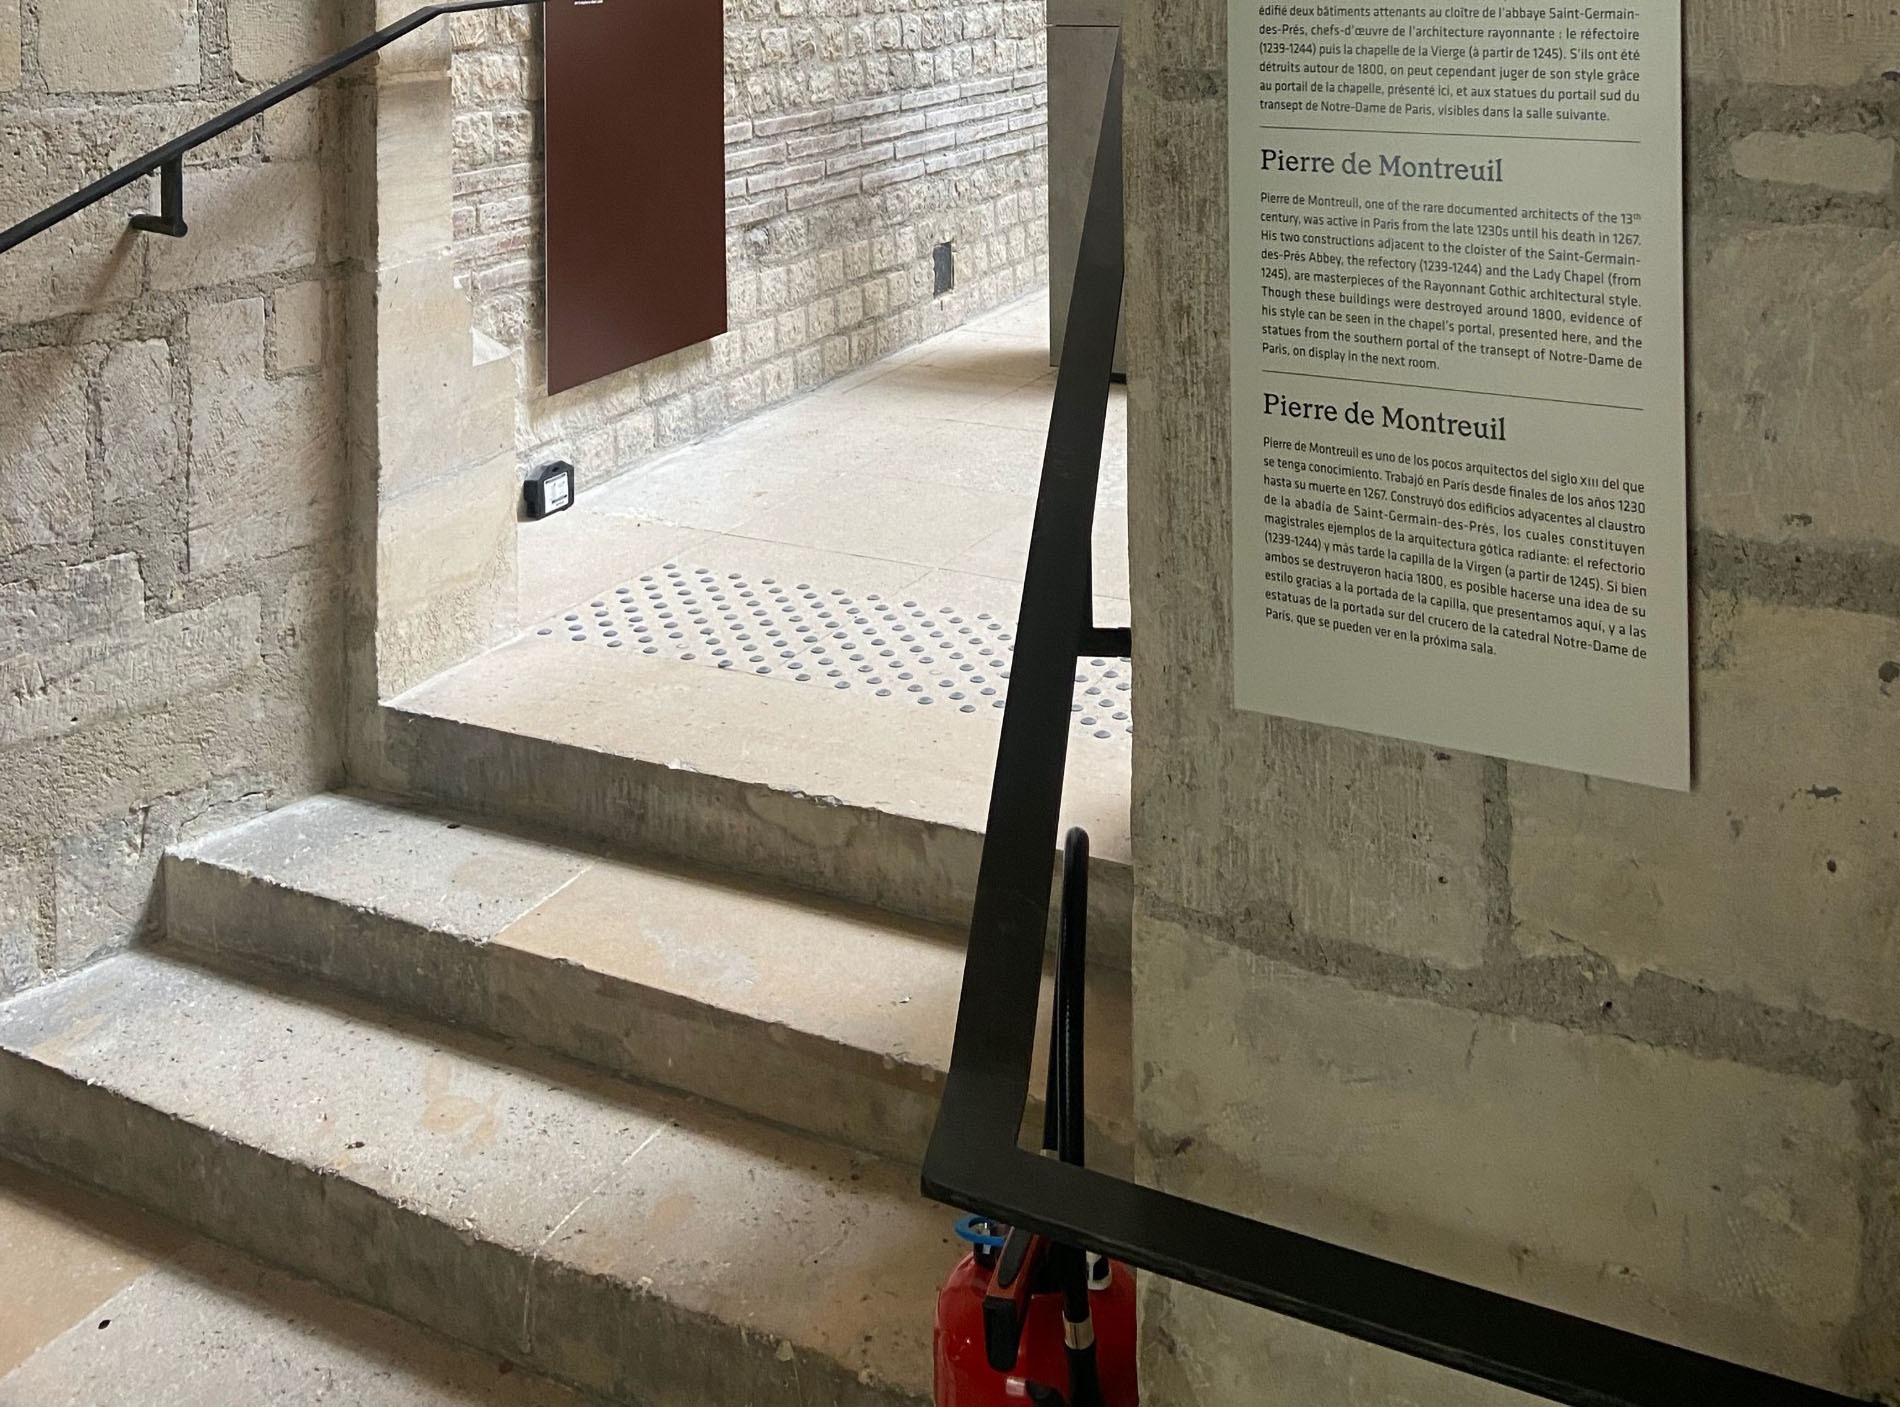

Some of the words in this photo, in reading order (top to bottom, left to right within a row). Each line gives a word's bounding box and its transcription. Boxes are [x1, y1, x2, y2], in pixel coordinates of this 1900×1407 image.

[1258, 4, 1288, 16] édifié
[1288, 4, 1314, 16] deux
[1316, 4, 1371, 17] bâtiments
[1372, 6, 1426, 18] attenants
[1428, 8, 1442, 18] au
[1481, 6, 1496, 18] de
[1548, 6, 1640, 20] Saint-Germain-
[1258, 60, 1300, 73] détruits
[1303, 63, 1339, 74] autour
[1341, 62, 1354, 75] de
[1389, 66, 1404, 75] on
[1407, 66, 1433, 78] peut
[1435, 65, 1496, 79] cependant
[1498, 66, 1529, 82] juger
[1531, 67, 1546, 79] de
[1549, 70, 1571, 80] son
[1574, 68, 1604, 83] style
[1606, 69, 1640, 84] grâce
[1259, 99, 1303, 113] transept
[1304, 99, 1319, 112] de
[1320, 100, 1386, 114] Notre-Dame
[1388, 102, 1402, 114] de
[1437, 104, 1480, 117] visibles
[1481, 105, 1510, 118] dans
[1512, 106, 1523, 119] la
[1526, 106, 1553, 120] salle
[1260, 148, 1335, 174] Pierre
[1340, 151, 1372, 176] de
[1378, 154, 1503, 182] Montreuil
[1260, 229, 1278, 241] His
[1279, 231, 1300, 243] two
[1302, 234, 1375, 248] constructions
[1377, 238, 1424, 252] adjacent
[1427, 241, 1440, 252] to
[1442, 241, 1462, 254] the
[1464, 243, 1506, 257] cloister
[1509, 245, 1522, 258] of
[1524, 247, 1545, 260] the
[1547, 248, 1640, 266] Saint-Germain-
[1260, 247, 1306, 262] des-Prés
[1346, 254, 1365, 266] the
[1367, 255, 1417, 272] refectory
[1418, 258, 1482, 277] (1239-1244)
[1485, 264, 1507, 277] and
[1509, 266, 1530, 279] the
[1532, 267, 1561, 283] Lady
[1563, 269, 1604, 286] Chapel
[1607, 272, 1641, 287] (from
[1260, 285, 1302, 302] Though
[1304, 288, 1336, 303] these
[1338, 291, 1390, 310] buildings
[1393, 298, 1421, 310] were
[1424, 298, 1482, 316] destroyed
[1486, 306, 1528, 318] around
[1569, 311, 1624, 327] evidence
[1628, 315, 1642, 328] of
[1261, 324, 1302, 338] statues
[1303, 326, 1330, 340] from
[1332, 329, 1351, 342] the
[1405, 338, 1439, 350] portal
[1442, 339, 1455, 351] of
[1457, 341, 1477, 354] the
[1479, 343, 1530, 360] transept
[1532, 347, 1546, 360] of
[1548, 349, 1624, 367] Notre-Dame
[1627, 356, 1643, 369] de
[1262, 392, 1338, 422] Pierre
[1343, 400, 1375, 426] de
[1381, 404, 1506, 441] Montreuil
[1262, 457, 1275, 468] se
[1276, 457, 1306, 473] tenga
[1384, 469, 1424, 487] Trabajó
[1426, 477, 1440, 488] en
[1442, 477, 1470, 492] París
[1471, 481, 1506, 497] desde
[1508, 484, 1548, 502] finales
[1549, 490, 1564, 504] de
[1567, 492, 1584, 506] los
[1586, 496, 1615, 510] años
[1617, 499, 1646, 514] 1230
[1264, 514, 1325, 531] magistrales
[1327, 520, 1376, 538] ejemplos
[1378, 528, 1392, 541] de
[1394, 529, 1405, 542] la
[1407, 533, 1476, 552] arquitectura
[1478, 542, 1514, 558] gótica
[1572, 555, 1584, 567] el
[1587, 557, 1646, 576] refectorio
[1264, 551, 1300, 566] ambos
[1302, 557, 1314, 568] se
[1316, 557, 1381, 578] destruyeron
[1384, 567, 1413, 583] hacia
[1449, 579, 1463, 590] es
[1465, 581, 1508, 597] posible
[1510, 585, 1555, 604] hacerse
[1558, 595, 1581, 608] una
[1584, 596, 1610, 612] idea
[1612, 601, 1629, 615] de
[1631, 606, 1646, 618] su
[1295, 614, 1316, 626] que
[1317, 617, 1330, 628] se
[1332, 620, 1372, 635] pueden
[1374, 627, 1391, 638] ver
[1393, 629, 1407, 641] en
[1409, 629, 1420, 643] la
[1422, 634, 1468, 651] próxima
